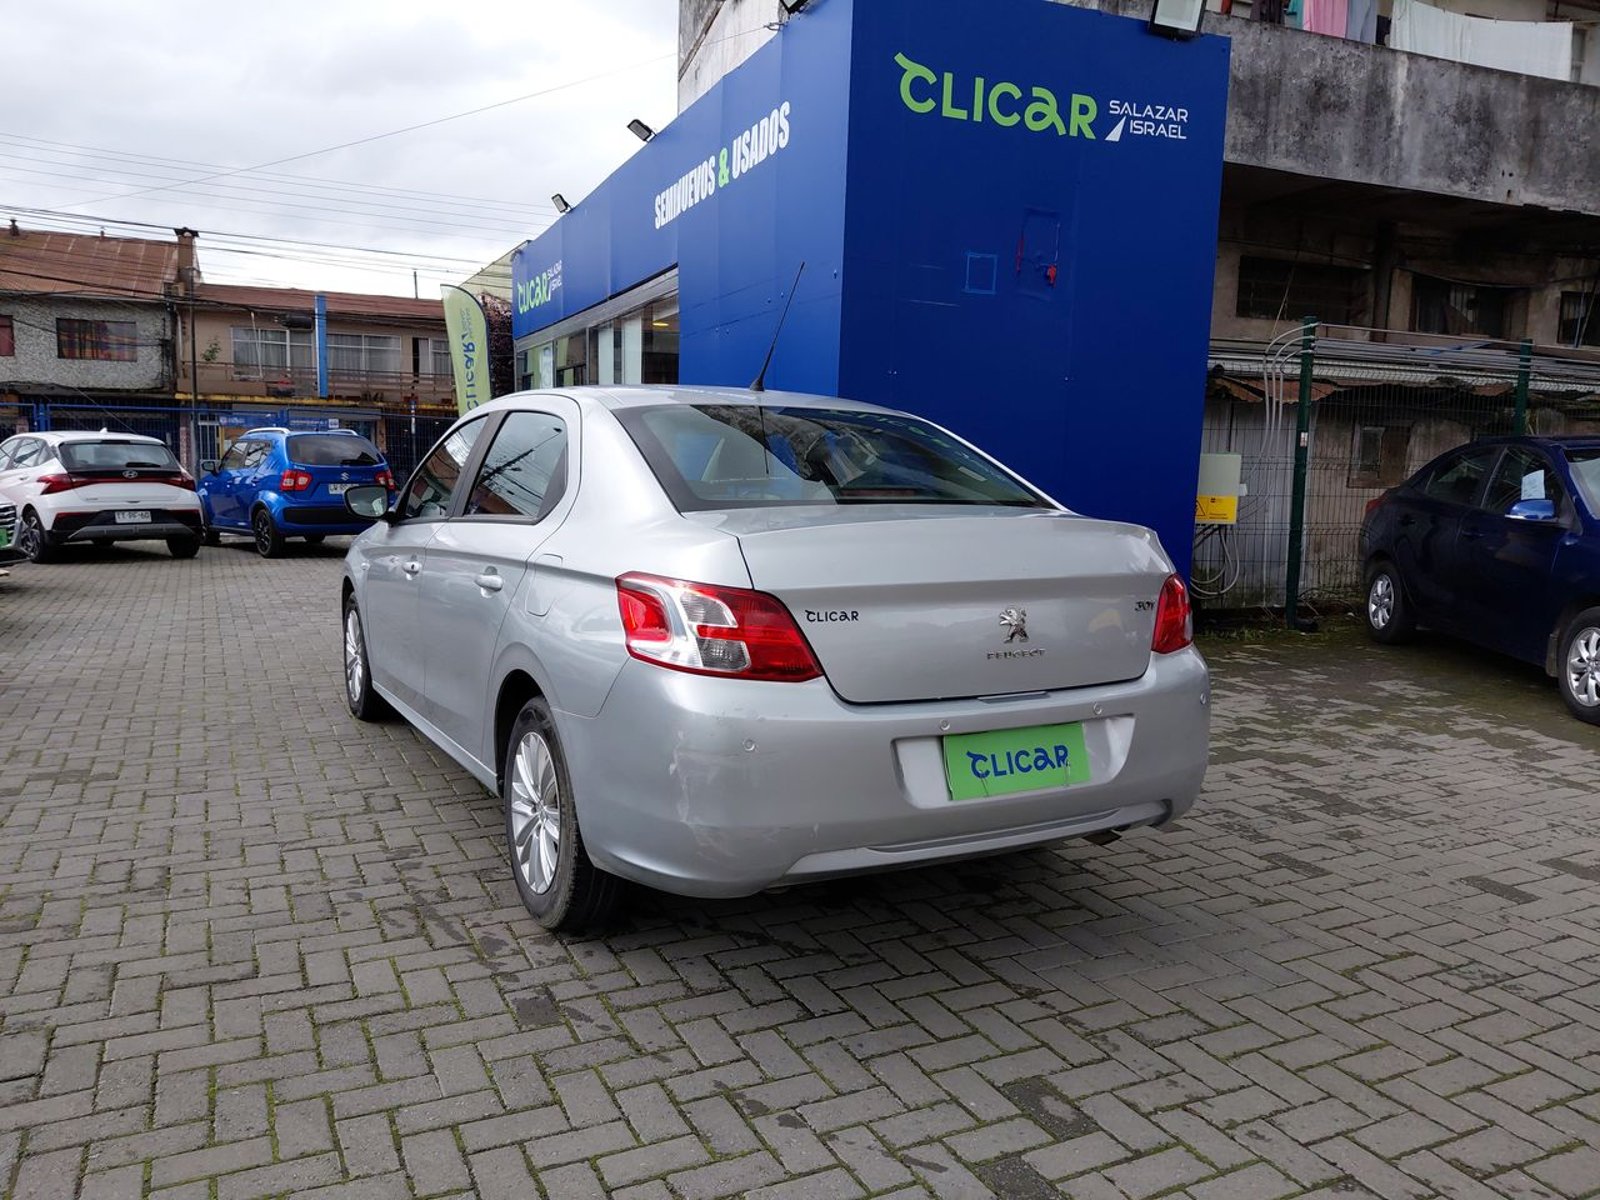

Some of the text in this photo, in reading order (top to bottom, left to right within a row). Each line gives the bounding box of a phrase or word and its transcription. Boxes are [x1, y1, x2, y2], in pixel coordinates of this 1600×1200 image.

[1108, 100, 1189, 123] SALAZAR
[1129, 119, 1188, 140] ISRAEL
[654, 101, 791, 229] SEMINUEVOS & USADOS
[986, 648, 1046, 660] PEUGEOT
